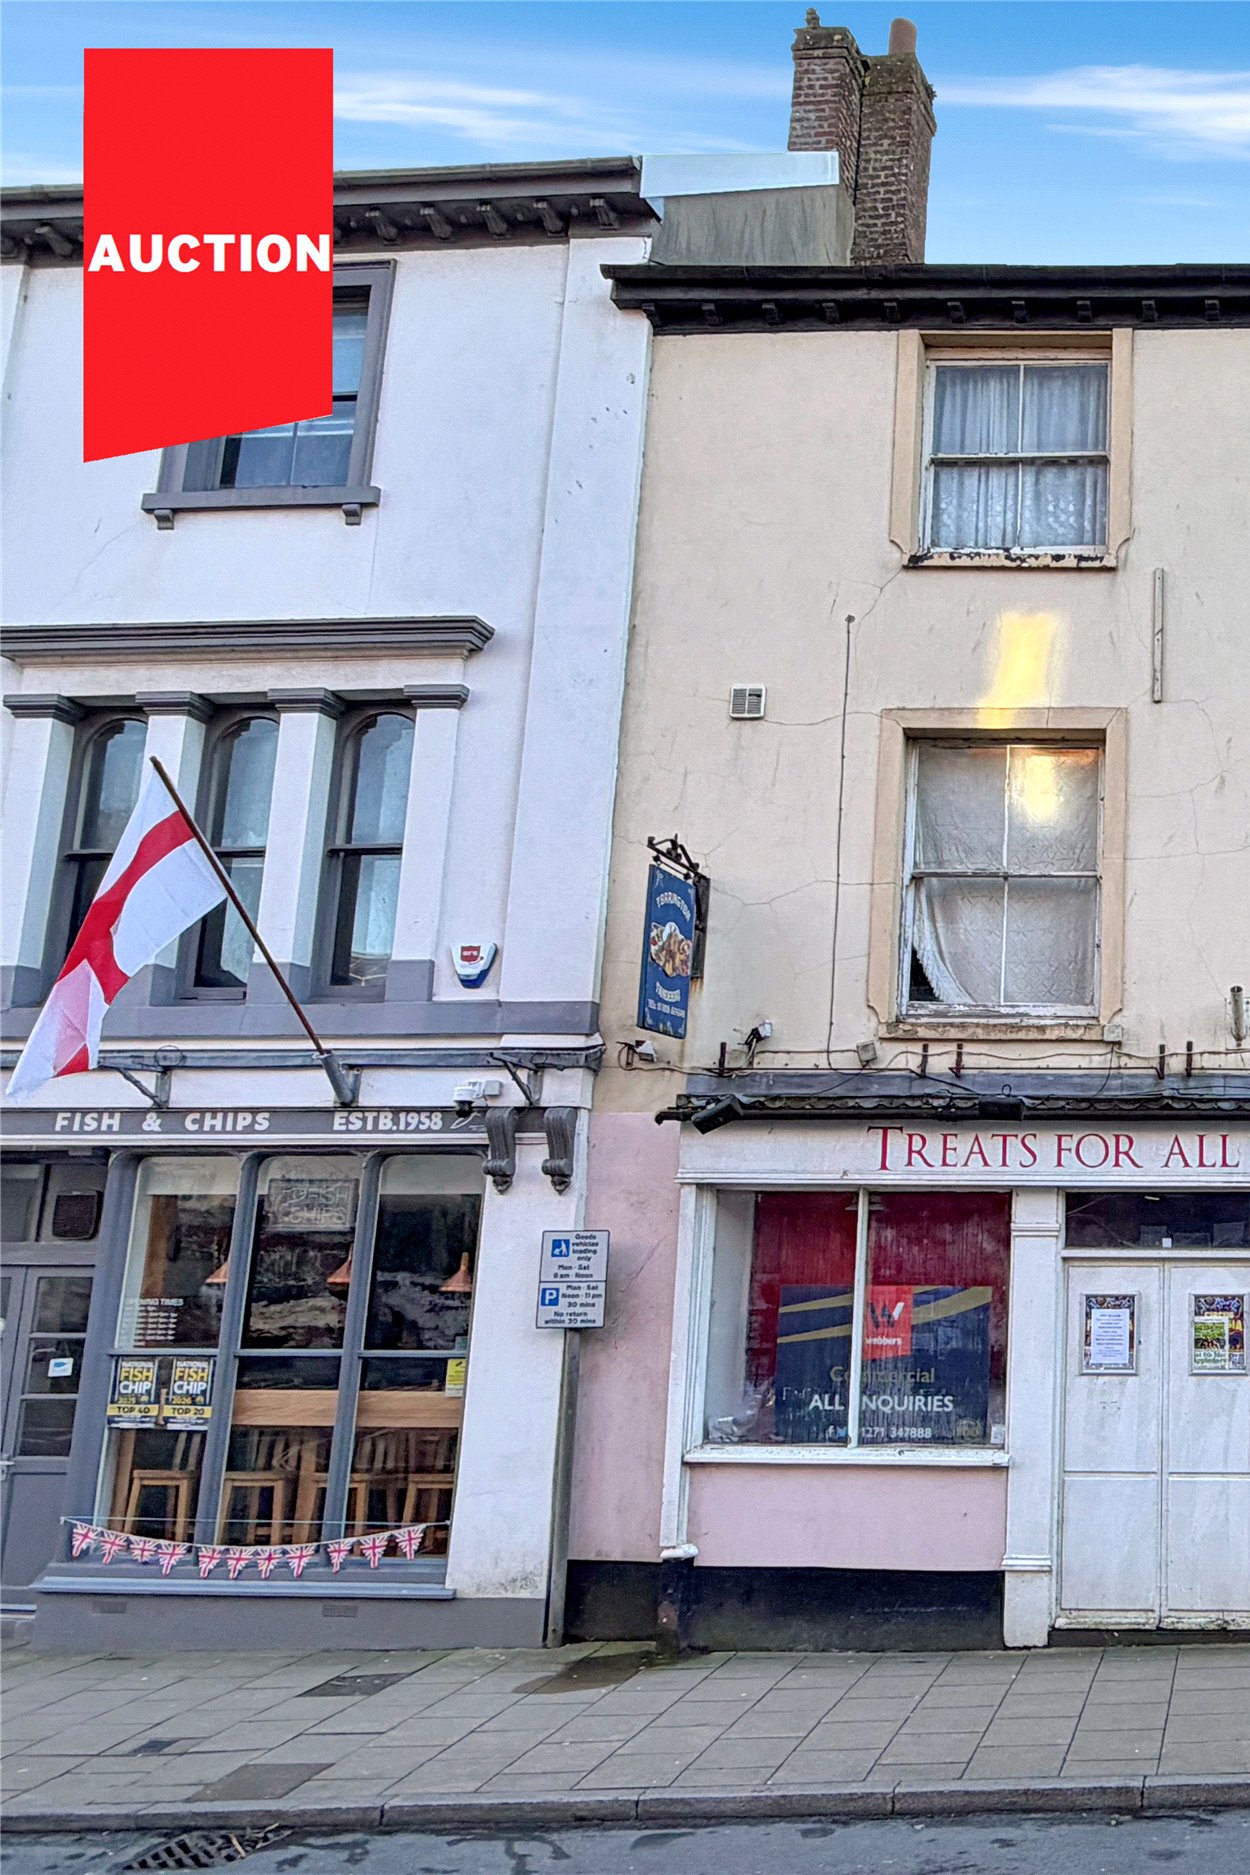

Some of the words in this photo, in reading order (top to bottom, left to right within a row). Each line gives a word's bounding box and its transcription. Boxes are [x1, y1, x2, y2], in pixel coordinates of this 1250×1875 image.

[54, 1112, 121, 1131] FISH
[142, 1112, 162, 1131] &
[184, 1112, 270, 1131] CHIPS
[867, 1125, 1037, 1172] TREATS
[1054, 1133, 1143, 1169] FOR
[1161, 1133, 1242, 1169] ALL
[545, 1290, 557, 1305] P
[120, 1367, 153, 1381] FISH
[175, 1367, 208, 1381] FISH
[119, 1381, 151, 1394] CHIP
[173, 1381, 207, 1394] CHIP
[117, 1406, 135, 1414] TOP
[171, 1407, 191, 1415] TOP
[809, 1395, 845, 1411] ALL
[861, 1395, 954, 1413] NQUIRIES
[890, 1426, 932, 1438] 347888
